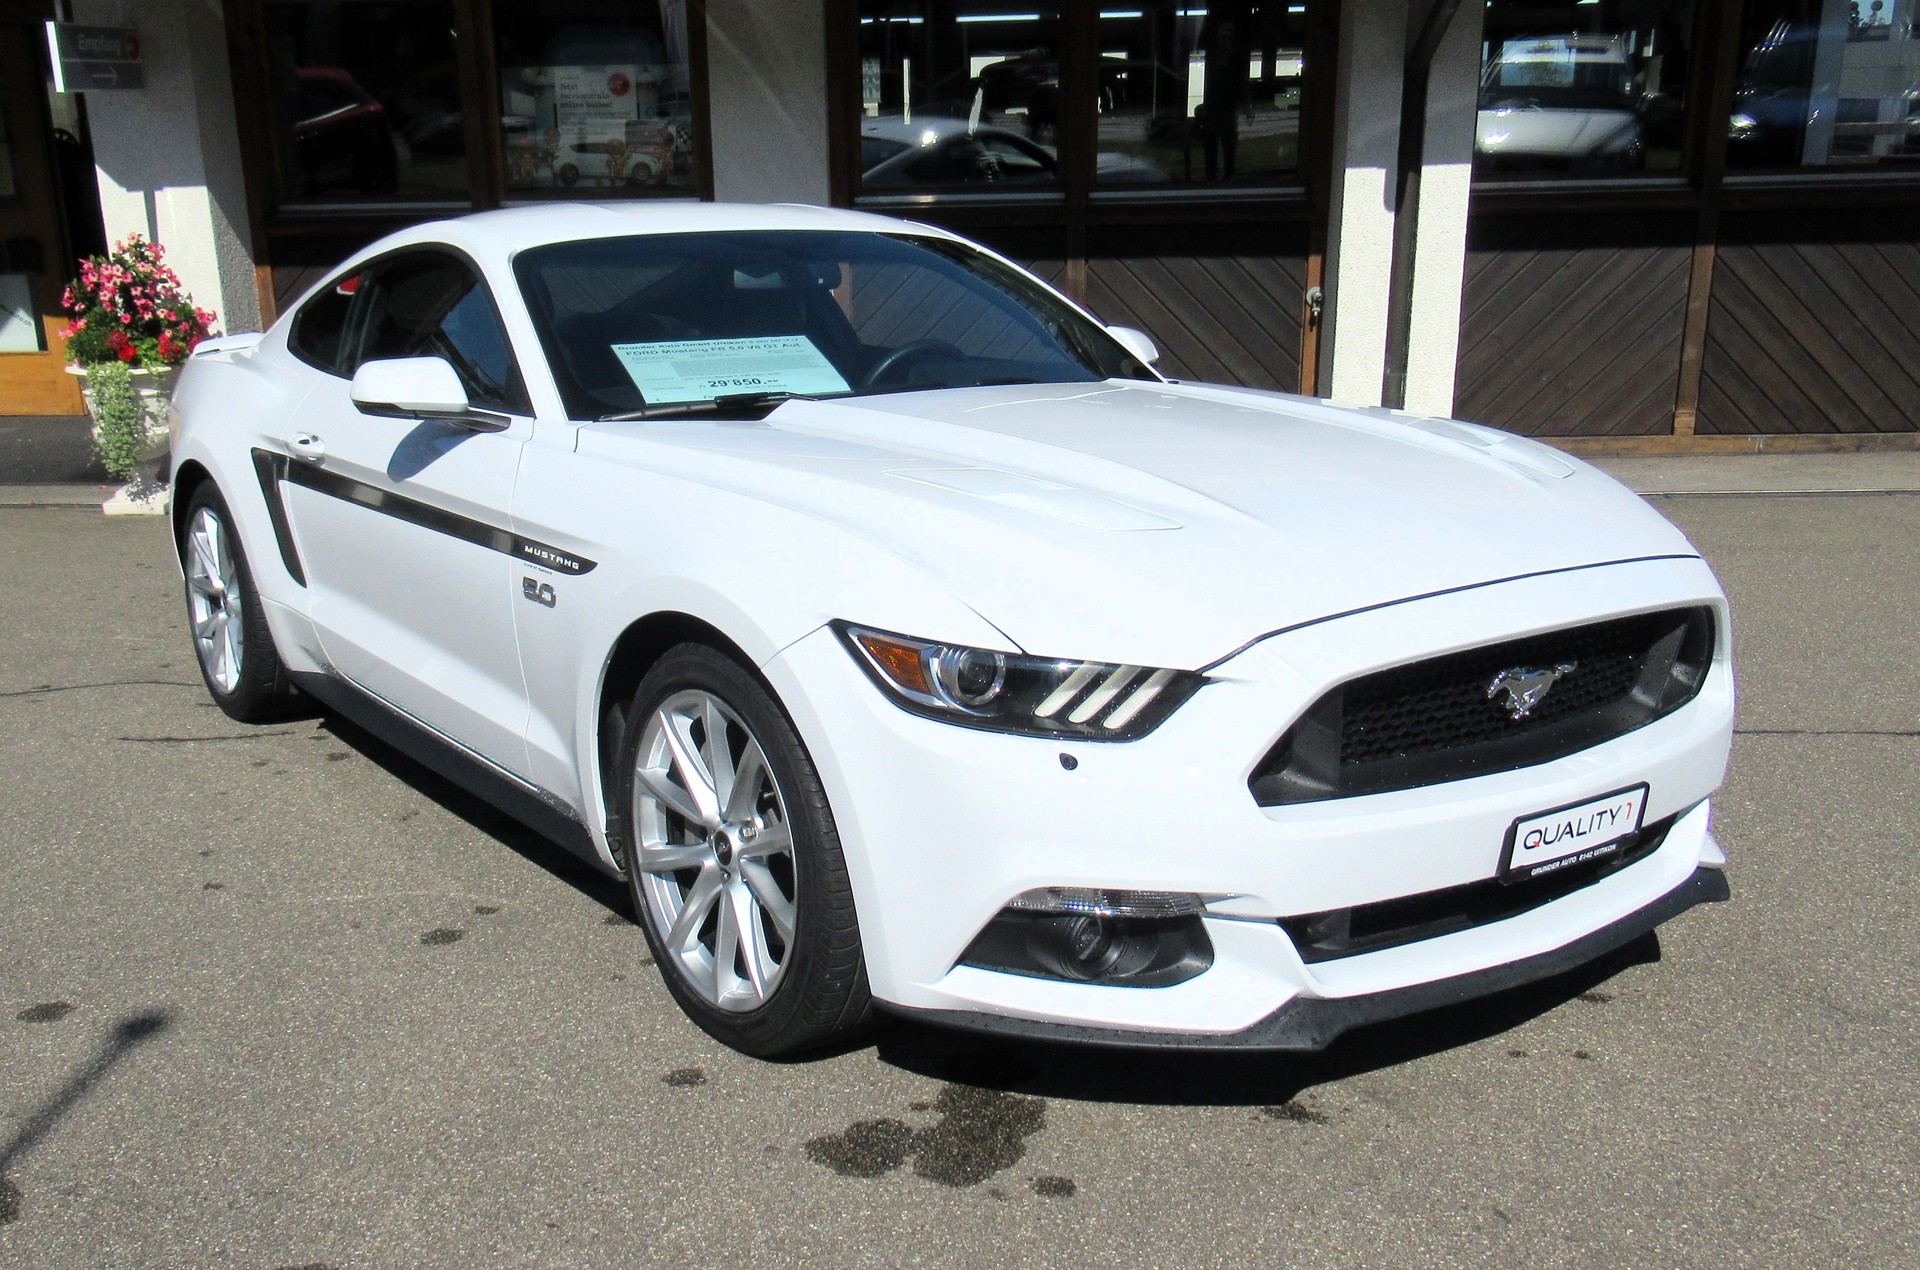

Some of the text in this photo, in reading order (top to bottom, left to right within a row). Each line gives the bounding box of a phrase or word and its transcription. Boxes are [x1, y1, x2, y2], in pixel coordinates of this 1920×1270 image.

[524, 545, 580, 570] MUSTANG
[1523, 804, 1622, 850] QUALITY
[1531, 843, 1617, 875] GRUNDER AUTO 8142 UITIKON
